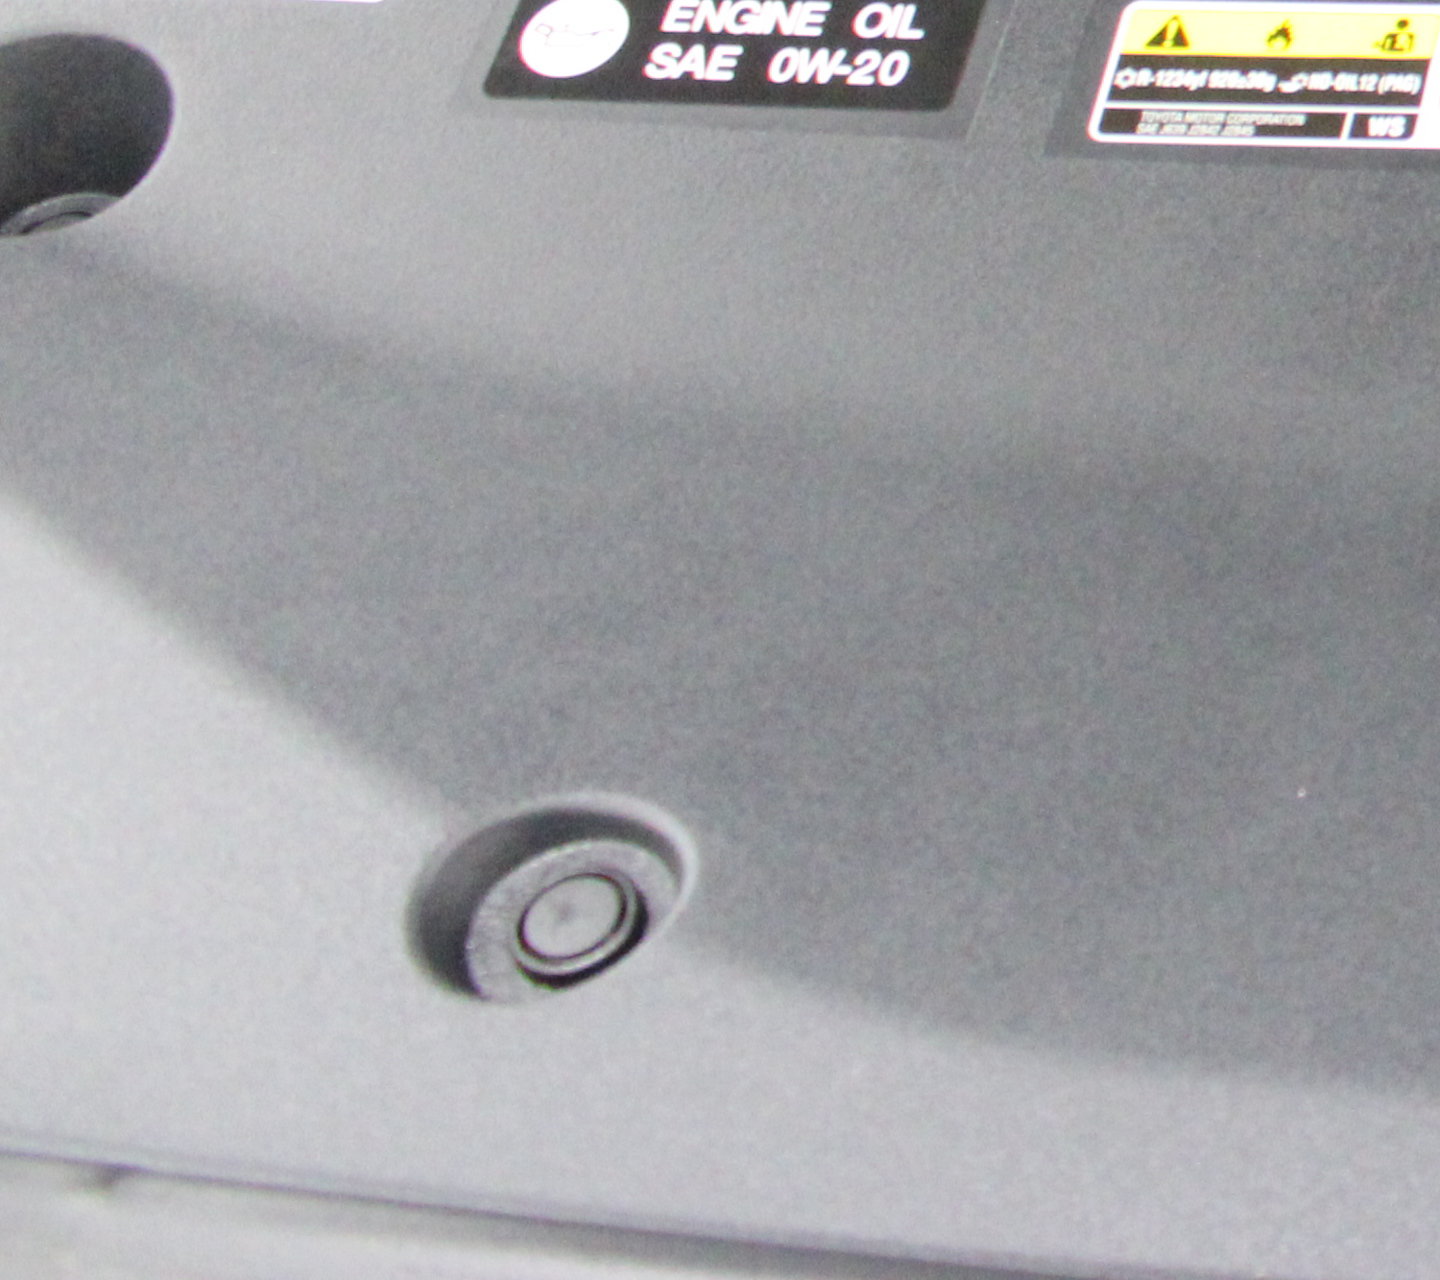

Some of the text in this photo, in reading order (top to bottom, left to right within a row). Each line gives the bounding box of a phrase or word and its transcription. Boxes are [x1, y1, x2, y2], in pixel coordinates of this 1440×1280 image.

[851, 1, 925, 40] OIL
[643, 42, 910, 88] SAE 0W-20
[1140, 110, 1307, 126] TOYOTA MOTOR CORPORATION
[1367, 115, 1408, 138] WS
